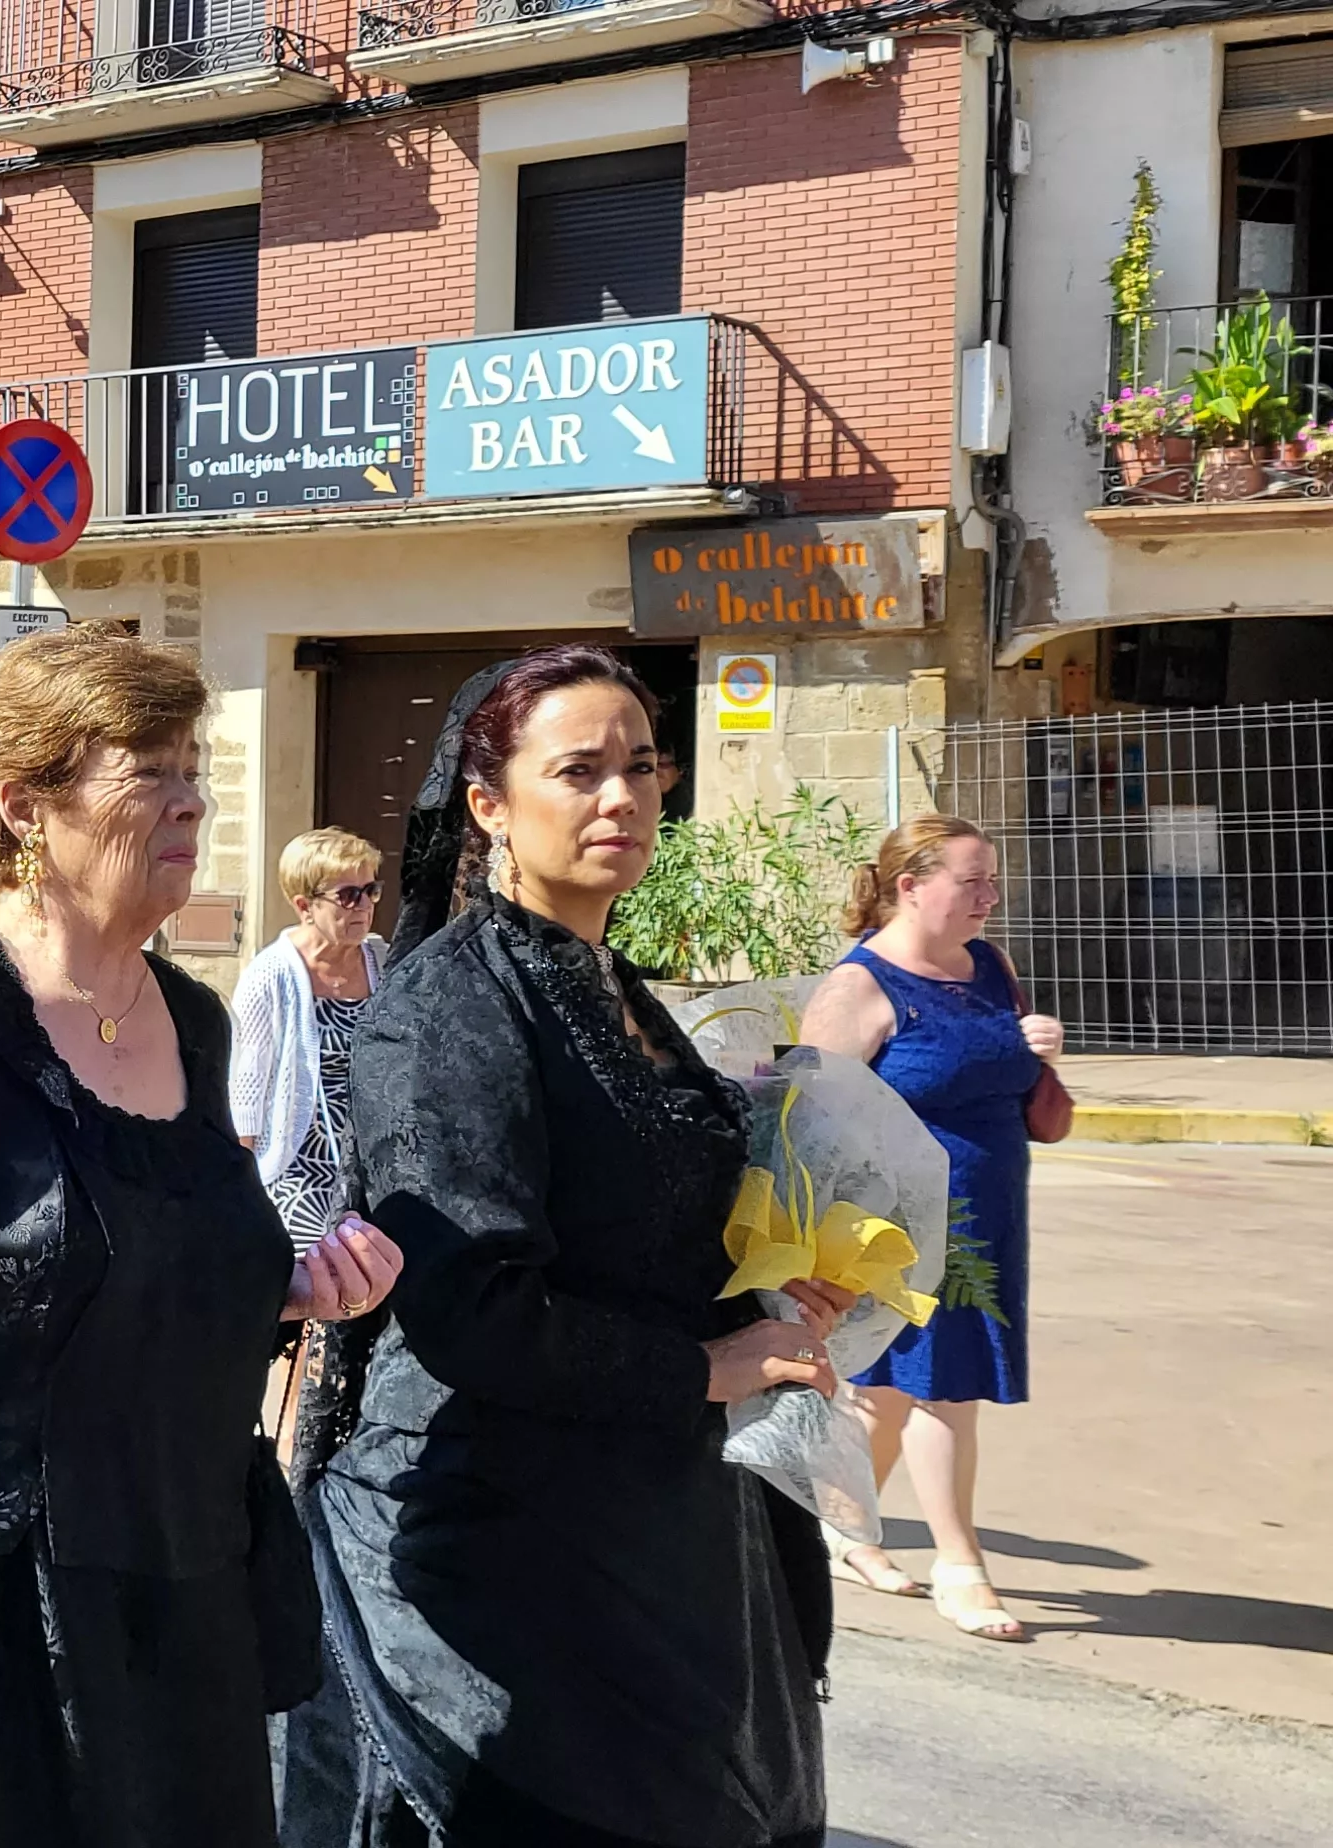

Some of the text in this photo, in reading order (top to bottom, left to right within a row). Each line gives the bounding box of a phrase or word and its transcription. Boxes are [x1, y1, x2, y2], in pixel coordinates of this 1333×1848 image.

[439, 338, 683, 410] ASADOR
[188, 361, 402, 447] HOTEL
[468, 413, 588, 472] BAR
[285, 448, 302, 463] de
[302, 443, 386, 469] belchite
[675, 590, 706, 611] de
[12, 613, 49, 623] EXCEPTO
[16, 625, 43, 634] CAR
